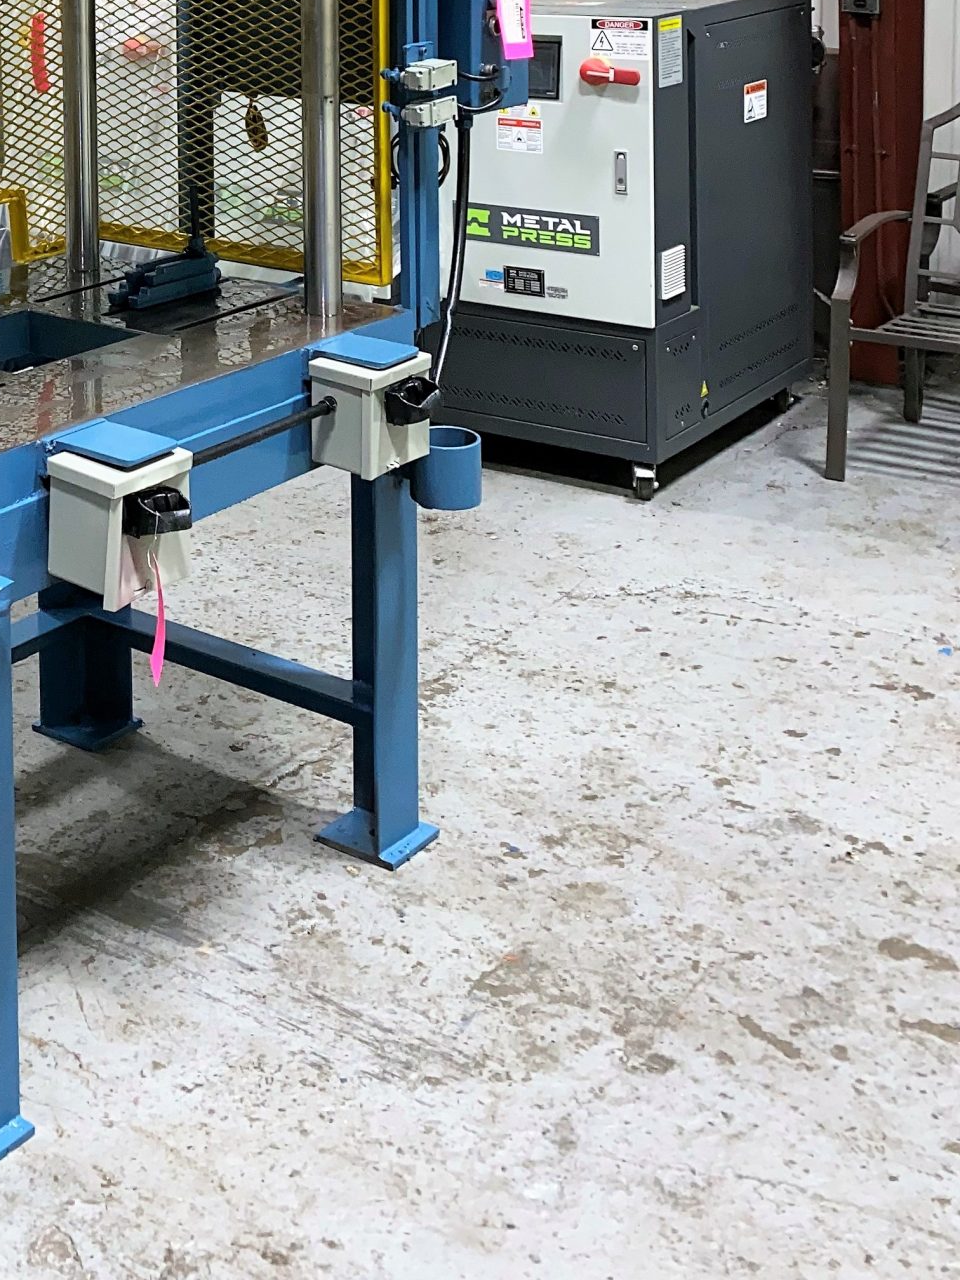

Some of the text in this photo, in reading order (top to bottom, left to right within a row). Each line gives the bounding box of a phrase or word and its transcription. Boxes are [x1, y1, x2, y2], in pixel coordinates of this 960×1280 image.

[604, 20, 635, 28] DANGER
[501, 212, 591, 235] METAL
[501, 226, 592, 249] PRESS
